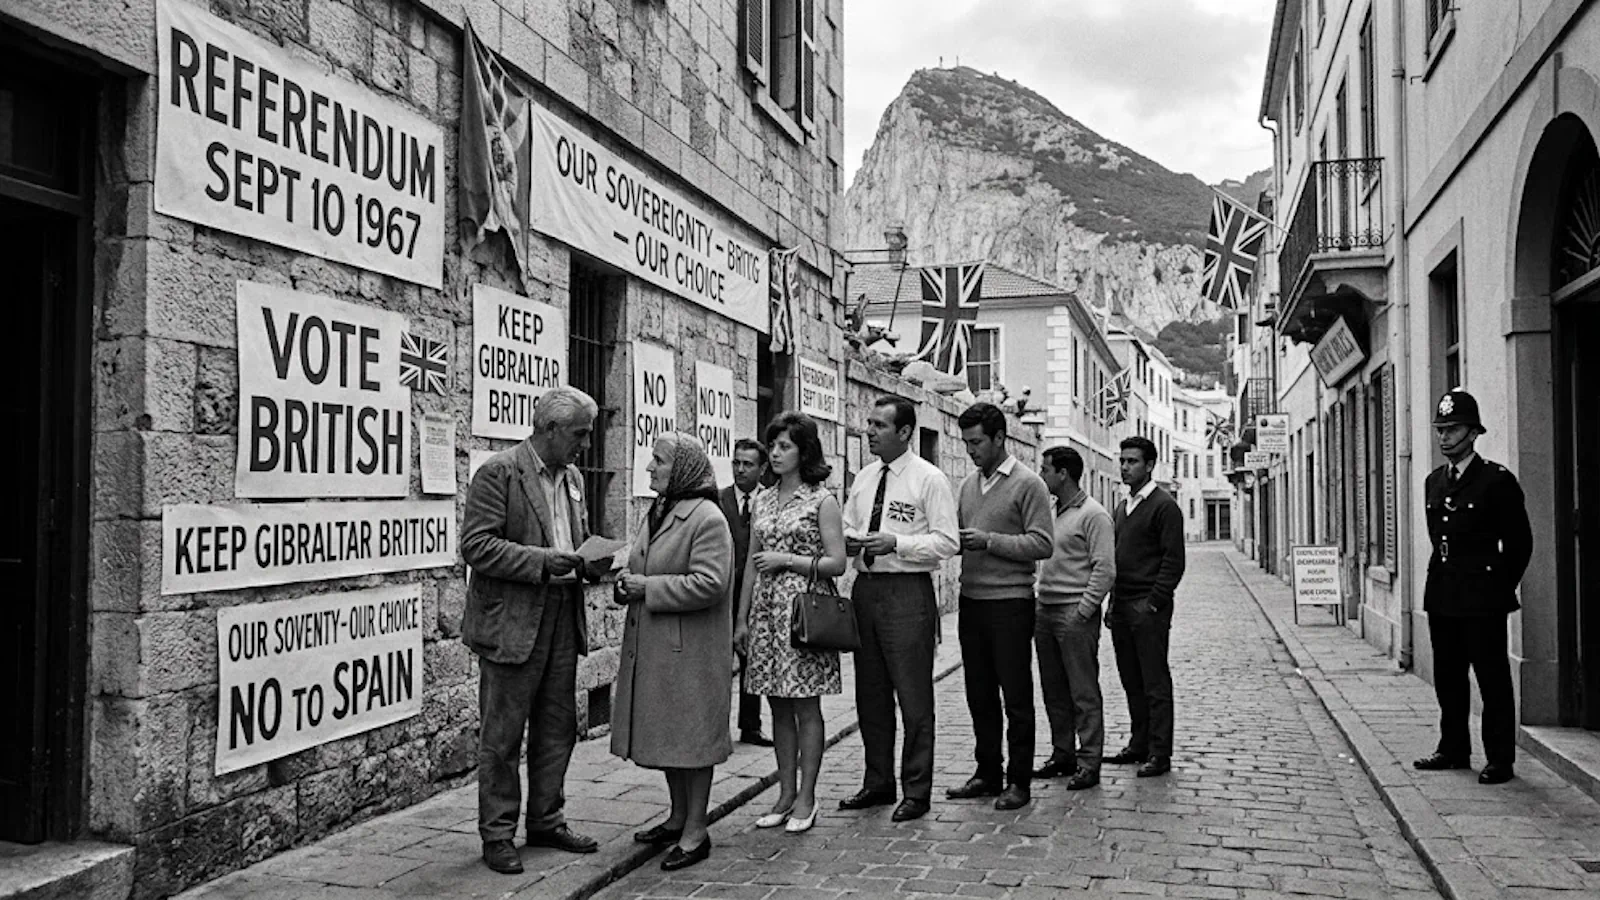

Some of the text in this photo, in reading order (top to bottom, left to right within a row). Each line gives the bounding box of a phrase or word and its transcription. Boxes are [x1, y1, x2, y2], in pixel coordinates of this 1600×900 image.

[170, 26, 435, 204] REFERENDUM
[205, 141, 421, 259] SEPT 10 1967
[556, 135, 597, 195] OUR
[605, 165, 713, 258] SOVEREIGNTY
[635, 231, 669, 279] OUR
[675, 252, 725, 305] CHOICE
[261, 306, 380, 392] VOTE
[498, 303, 543, 345] KEEP
[479, 343, 559, 388] GIBRALTAR
[644, 370, 666, 407] NO
[250, 396, 403, 475] BRITISH
[700, 386, 731, 420] NO TO
[699, 424, 730, 458] SPAIN
[175, 517, 447, 575] KEEP GIBRALTAR BRITISH
[228, 621, 268, 662] OUR
[379, 597, 418, 635] CHOICE
[230, 648, 413, 750] NO TO SPAIN
